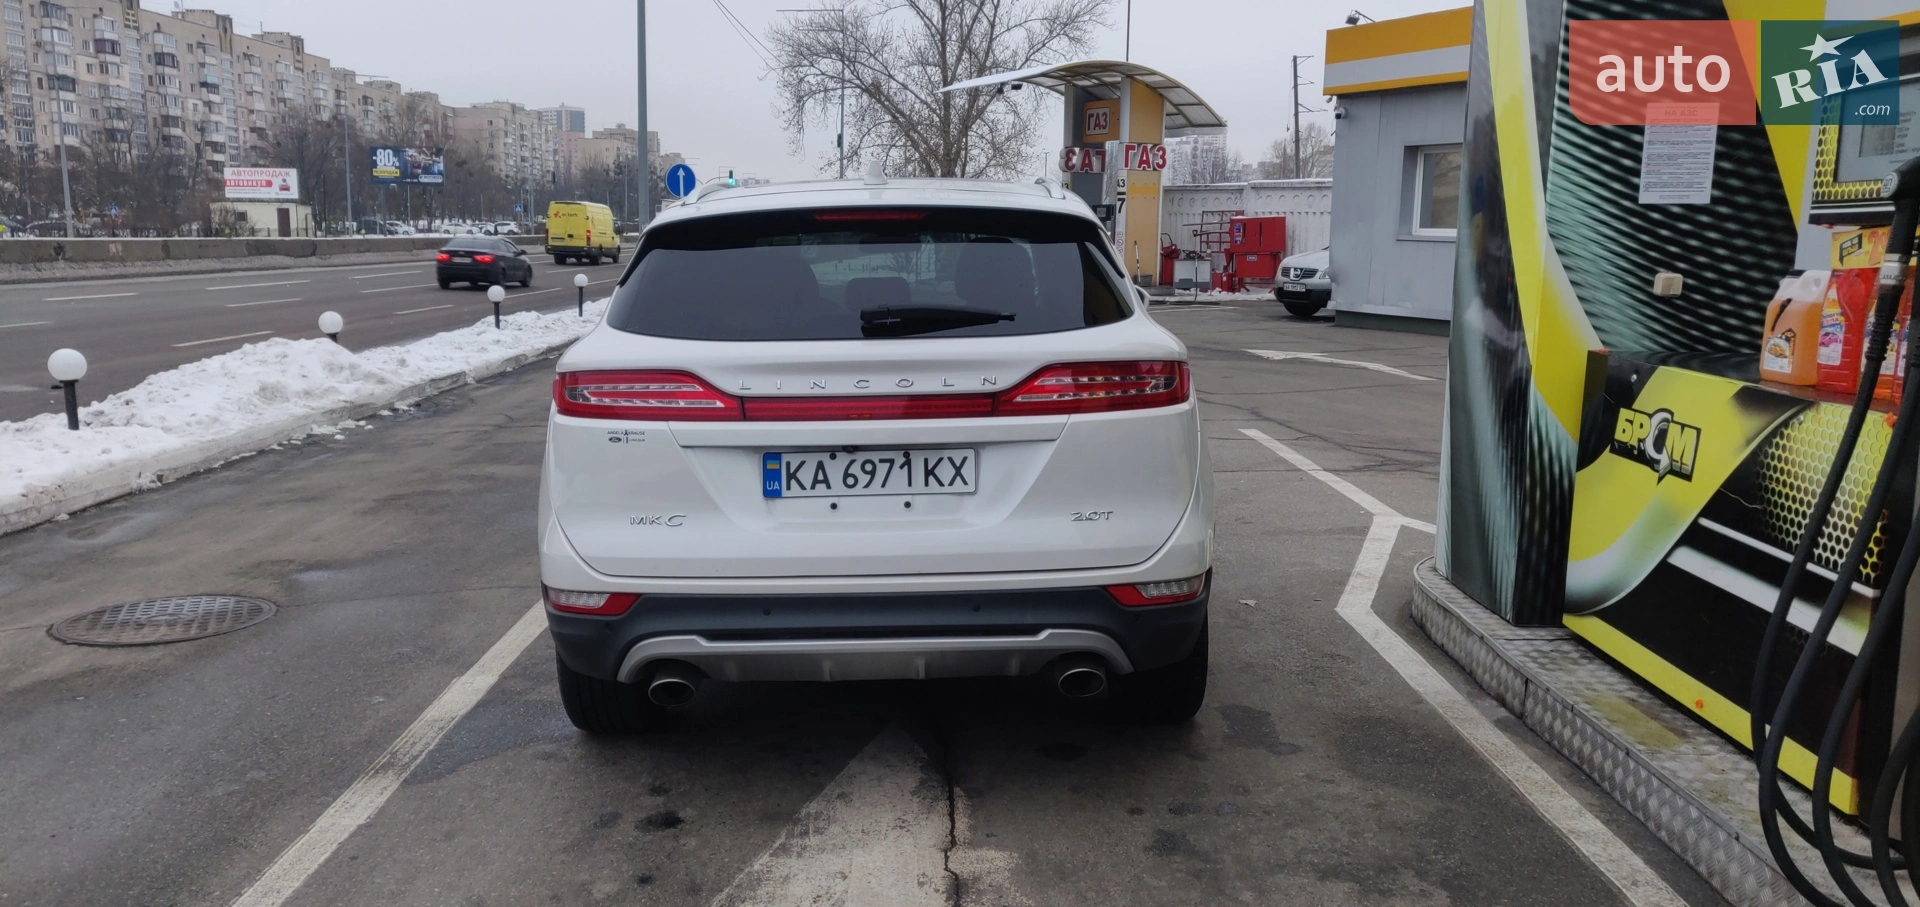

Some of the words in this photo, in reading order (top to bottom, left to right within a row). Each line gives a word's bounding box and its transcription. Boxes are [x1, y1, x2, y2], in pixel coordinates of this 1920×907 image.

[1087, 111, 1108, 131] ГАЗ
[372, 148, 400, 166] -80%
[1123, 143, 1167, 171] ГАЗ
[231, 169, 291, 178] АВТОПРОДАЖ
[738, 375, 998, 390] LINCOLN
[785, 460, 832, 491] KA
[842, 458, 913, 489] 6971
[923, 456, 969, 487] KX
[766, 481, 780, 491] UA
[630, 513, 687, 527] MKC
